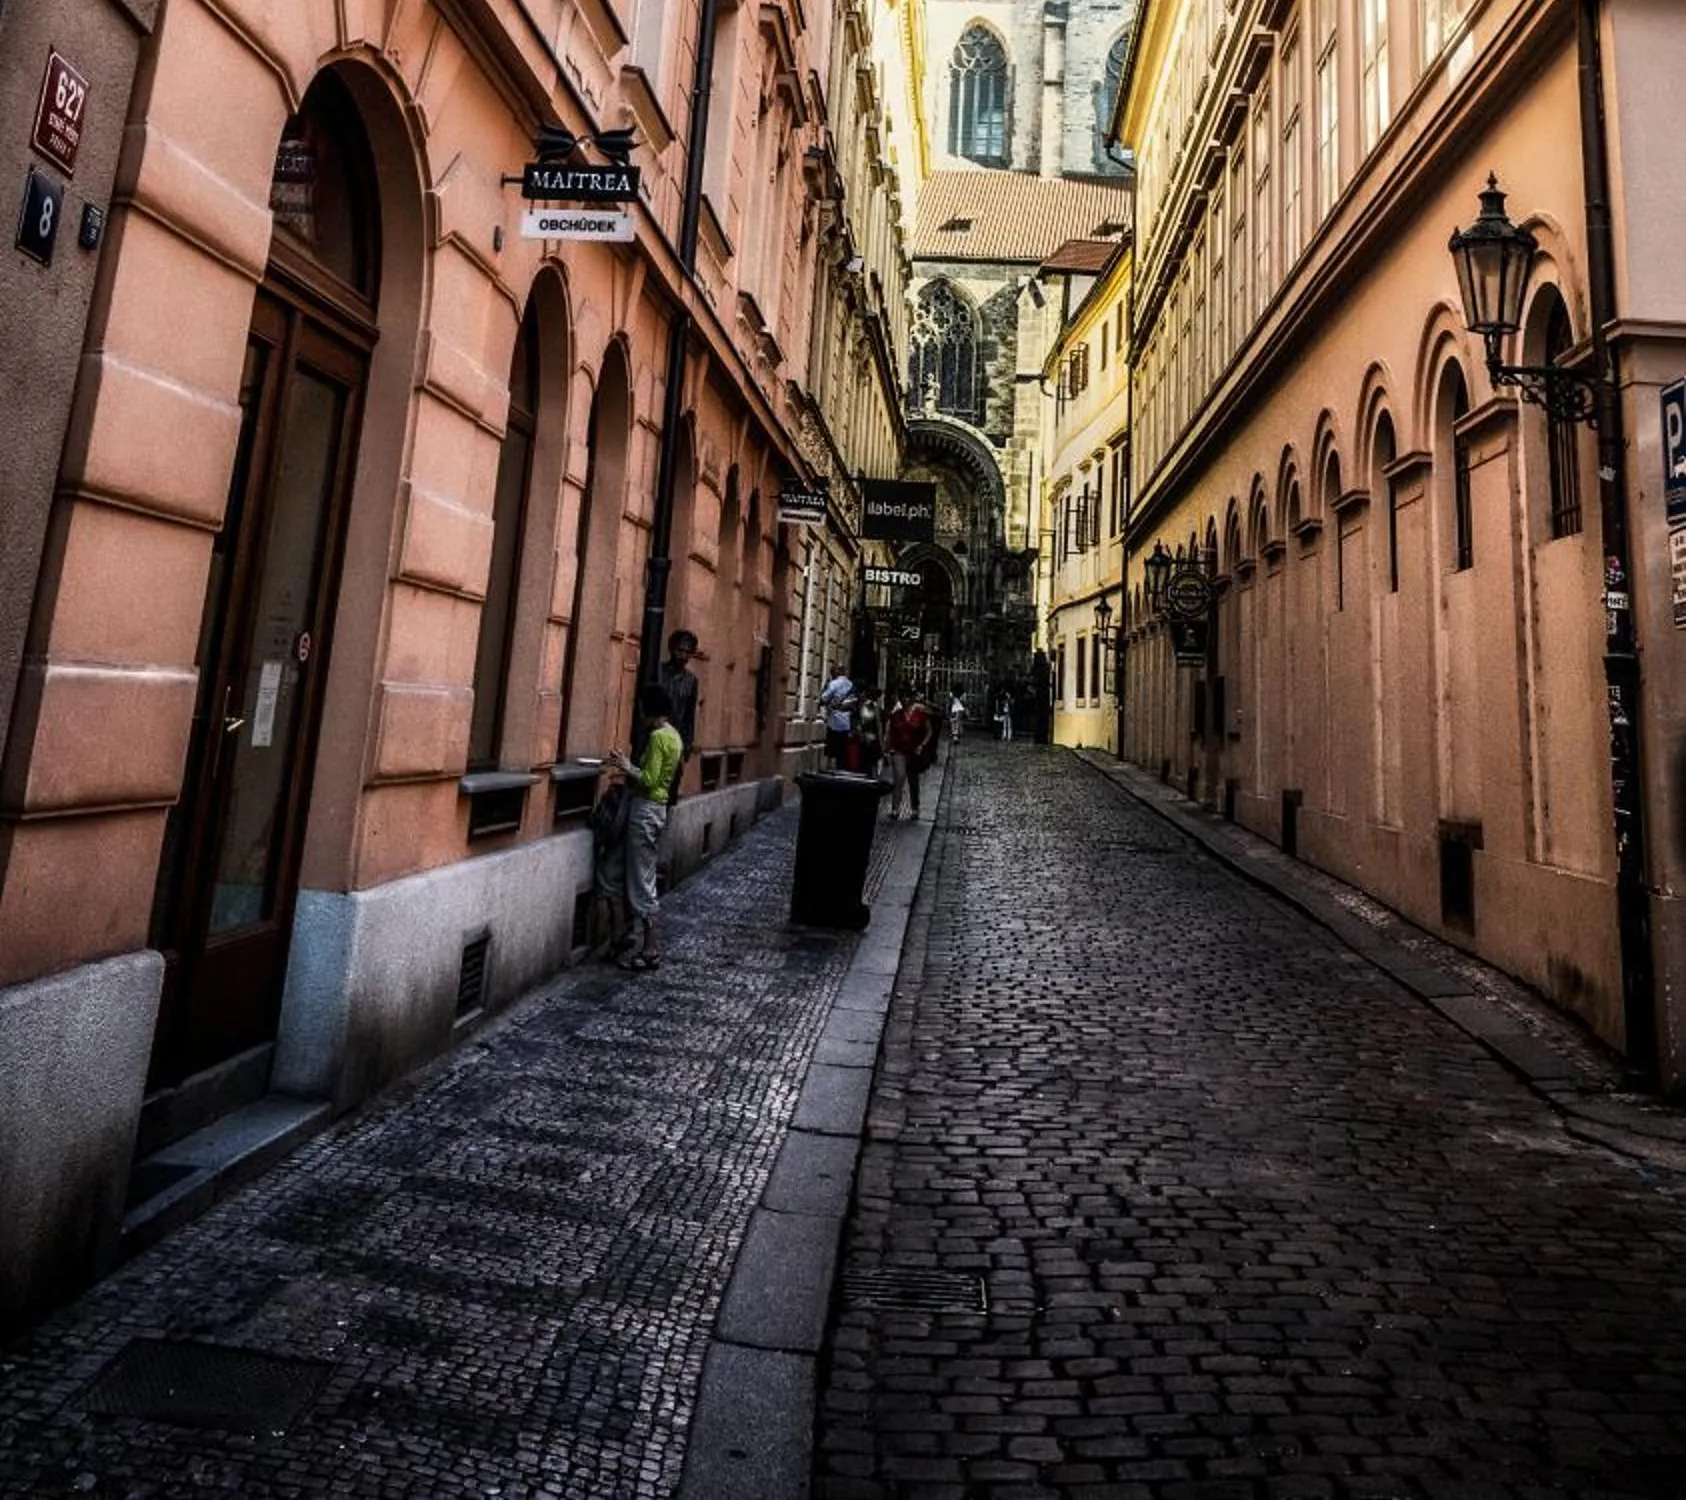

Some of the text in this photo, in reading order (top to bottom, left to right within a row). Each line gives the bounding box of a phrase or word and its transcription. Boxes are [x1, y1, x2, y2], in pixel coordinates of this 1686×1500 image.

[55, 71, 84, 121] 627
[531, 171, 631, 191] MAITREA
[39, 196, 53, 238] 8
[1666, 401, 1683, 479] P
[865, 569, 921, 585] BISTRO
